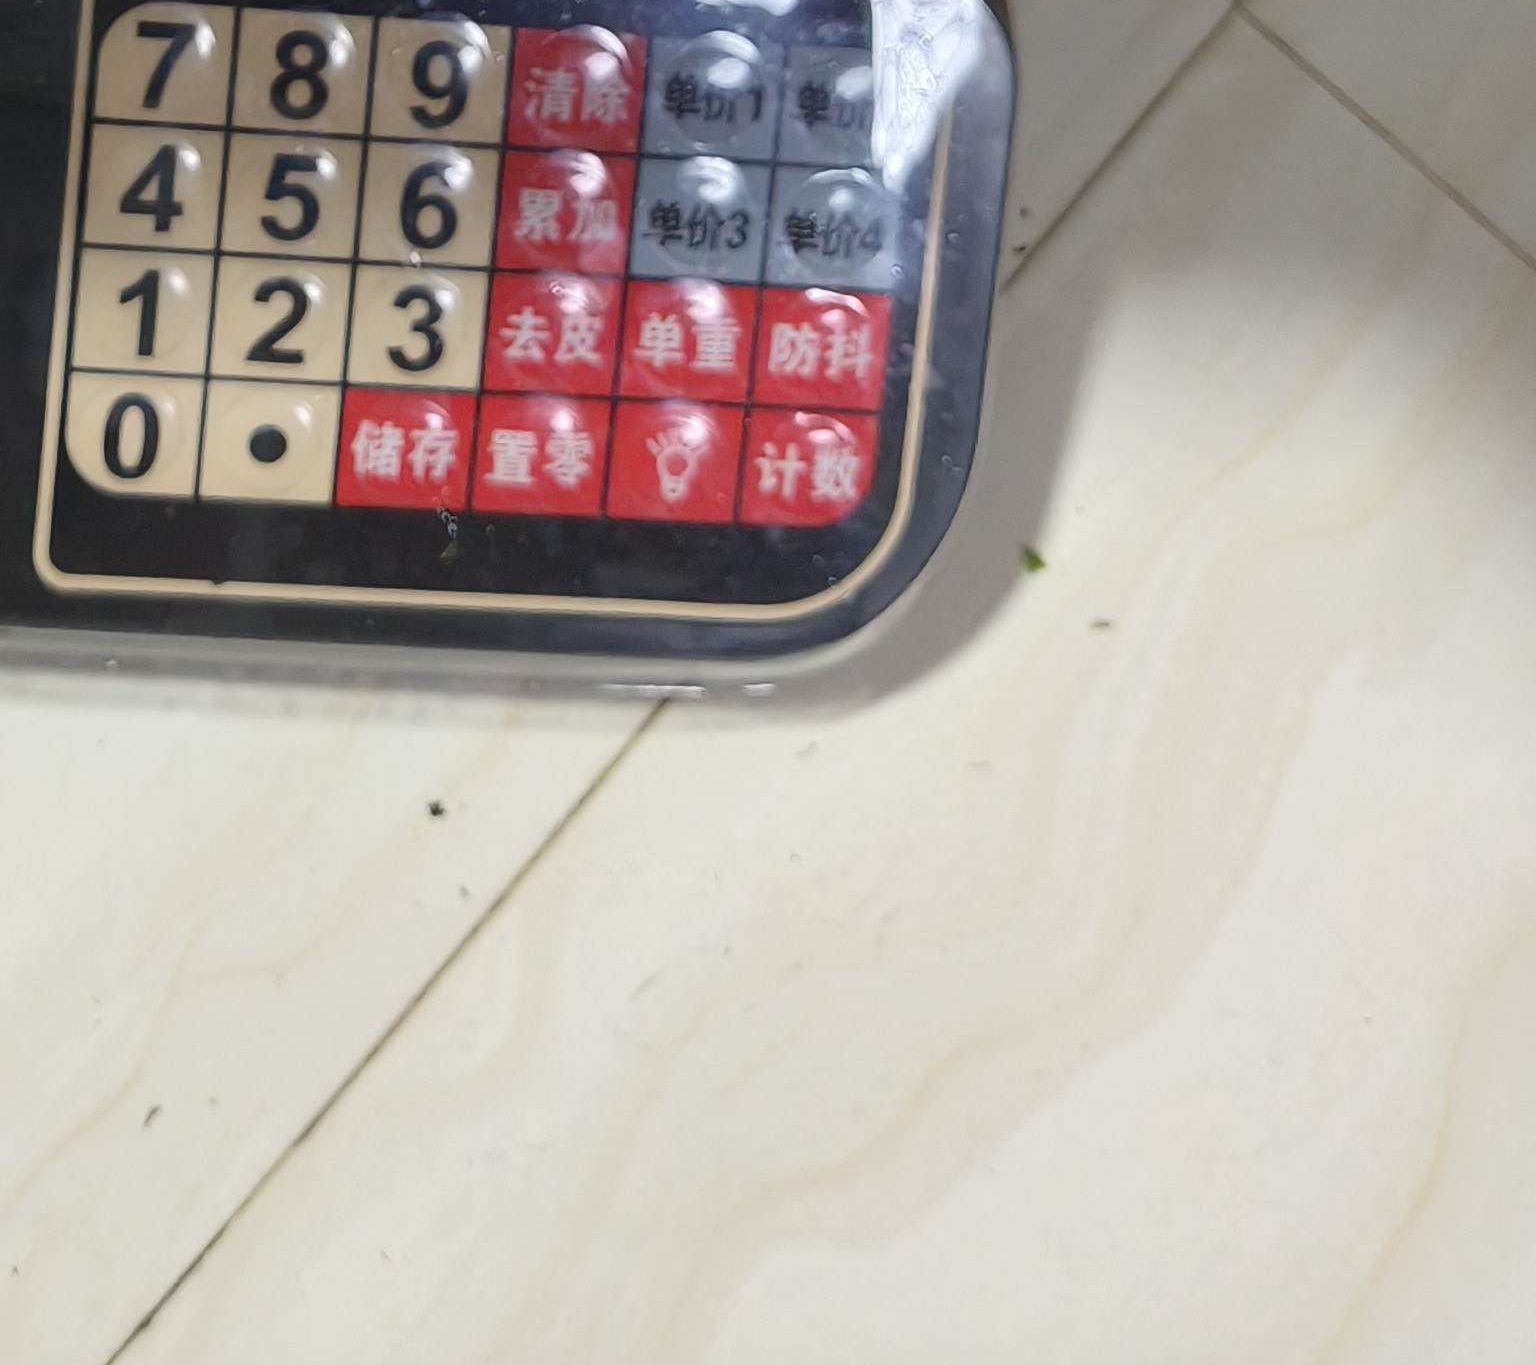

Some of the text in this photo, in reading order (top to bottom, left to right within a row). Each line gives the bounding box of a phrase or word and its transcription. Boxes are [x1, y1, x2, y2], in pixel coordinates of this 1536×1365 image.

[136, 21, 198, 109] 7
[270, 30, 329, 120] 8
[409, 40, 470, 128] 9
[119, 144, 184, 232] 4
[260, 153, 320, 241] 5
[399, 160, 459, 249] 6
[119, 269, 160, 357] 1
[246, 277, 309, 365] 2
[388, 284, 445, 371] 3
[498, 305, 605, 367] 去皮
[632, 312, 742, 371] 单重
[103, 391, 160, 479] 0
[350, 418, 461, 483] 储存
[482, 427, 595, 489] 置零
[754, 441, 861, 502] 计数
